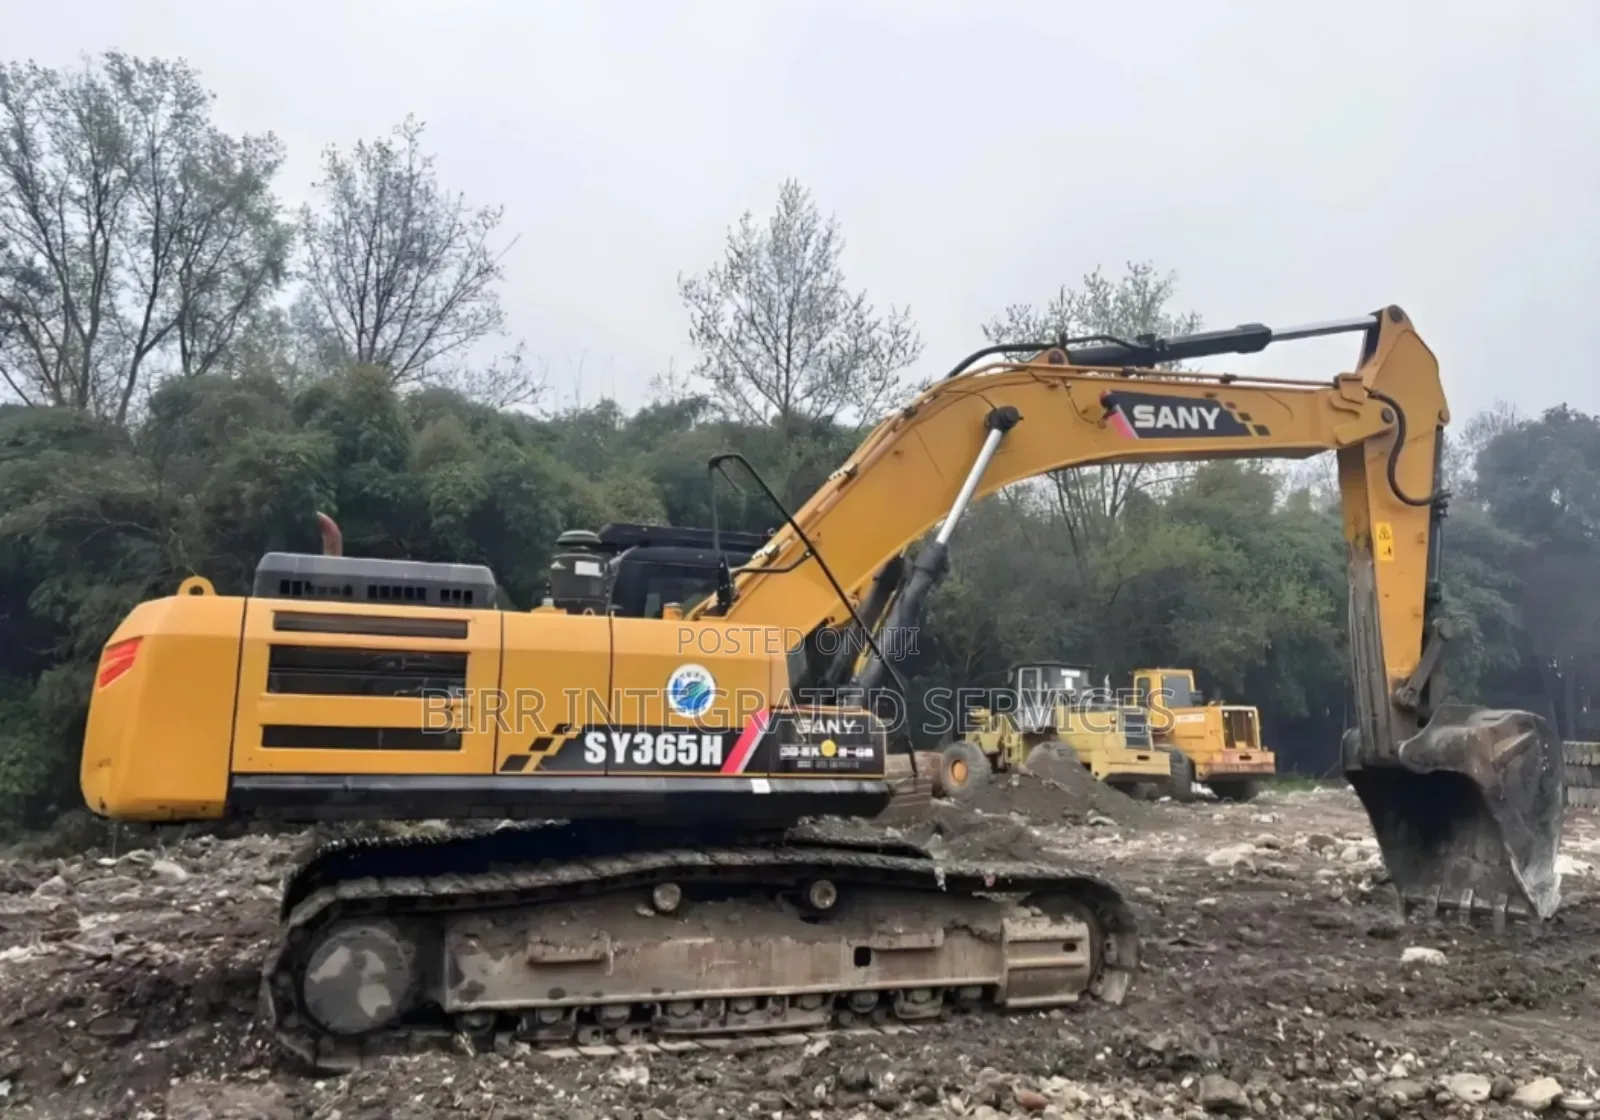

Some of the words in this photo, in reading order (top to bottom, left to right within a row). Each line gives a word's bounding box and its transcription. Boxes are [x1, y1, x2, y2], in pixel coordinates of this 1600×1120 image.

[1132, 404, 1220, 430] SANY
[798, 719, 856, 734] SANY
[583, 731, 722, 766] SY365H
